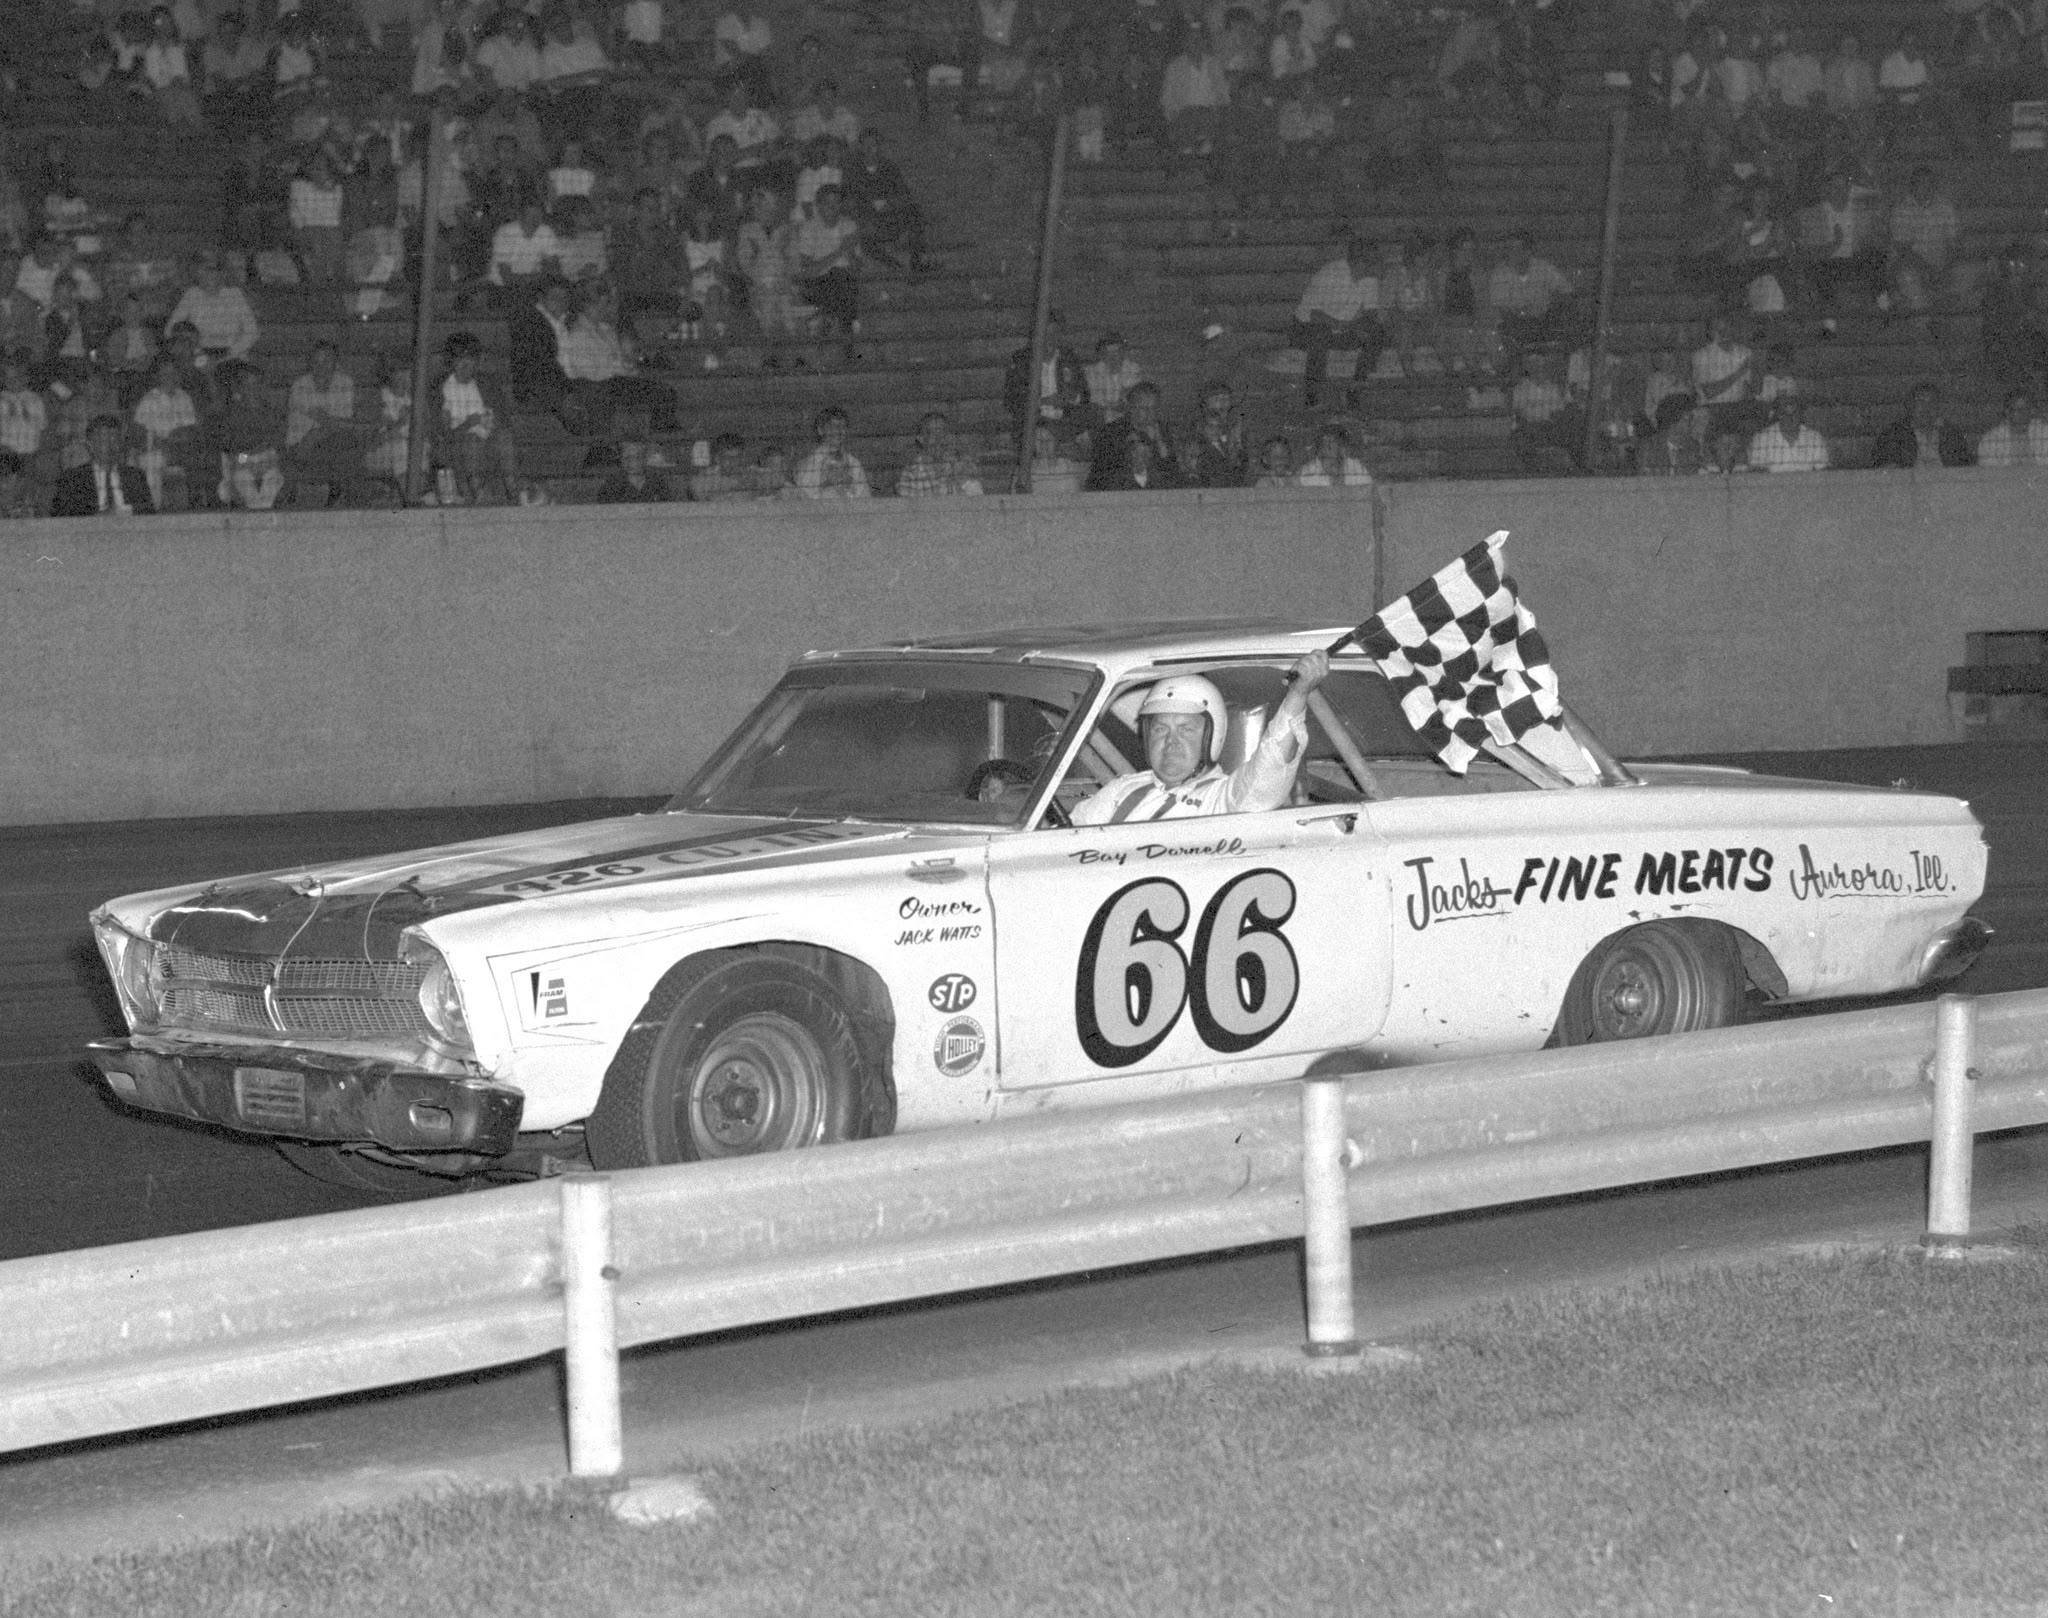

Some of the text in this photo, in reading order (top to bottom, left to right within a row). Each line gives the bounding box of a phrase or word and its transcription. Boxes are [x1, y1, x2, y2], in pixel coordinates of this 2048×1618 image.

[504, 864, 645, 892] 426
[1513, 853, 1622, 906] FINE
[1634, 847, 1774, 896] MEATS
[899, 896, 982, 920] Owner
[894, 925, 982, 946] JACK WATTS
[1075, 867, 1300, 1069] 66
[540, 989, 564, 999] FRAM
[931, 975, 974, 1010] STP
[947, 1036, 979, 1060] HOLLEY
